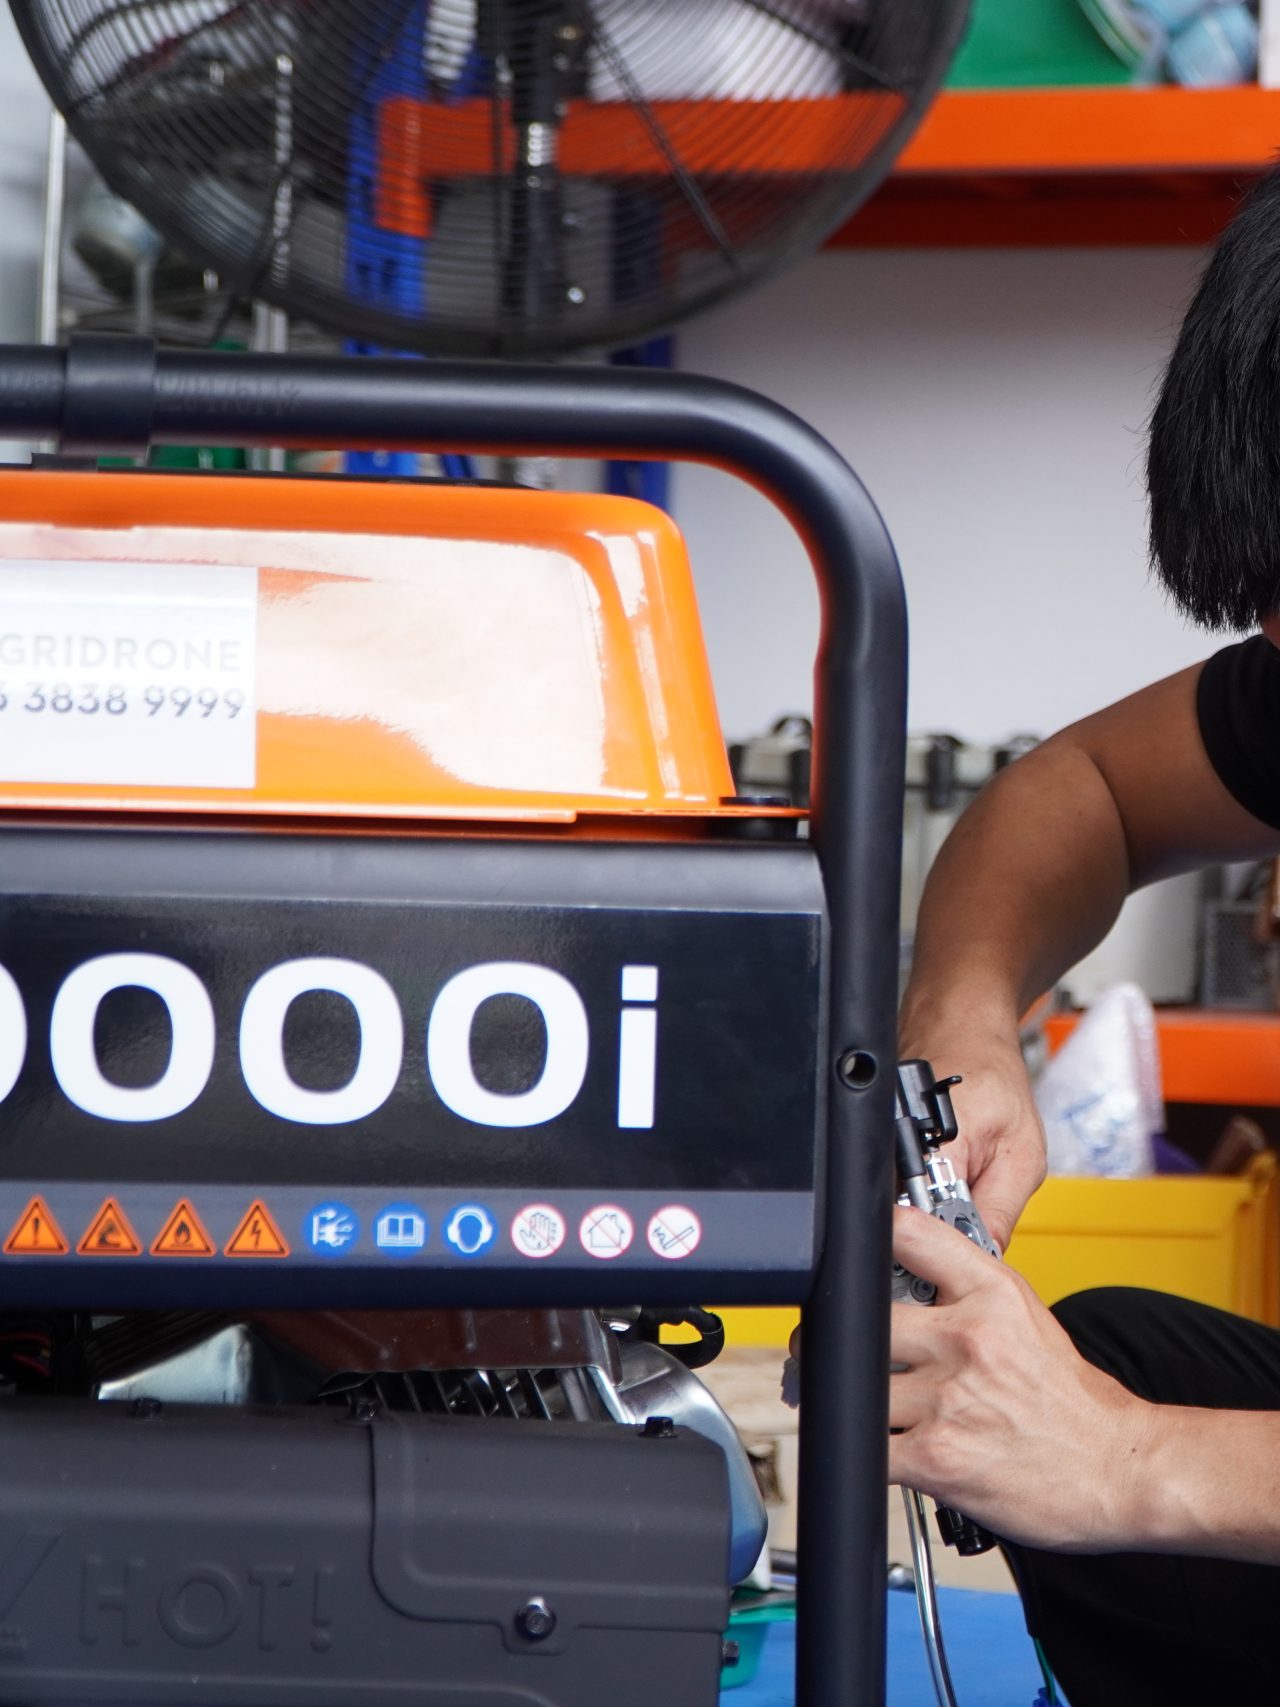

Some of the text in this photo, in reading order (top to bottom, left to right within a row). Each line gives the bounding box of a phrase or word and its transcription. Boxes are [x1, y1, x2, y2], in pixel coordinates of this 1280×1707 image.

[23, 681, 128, 715] 3838
[143, 685, 245, 720] 9999
[0, 952, 658, 1129] 000i
[78, 1554, 335, 1652] HOT!
